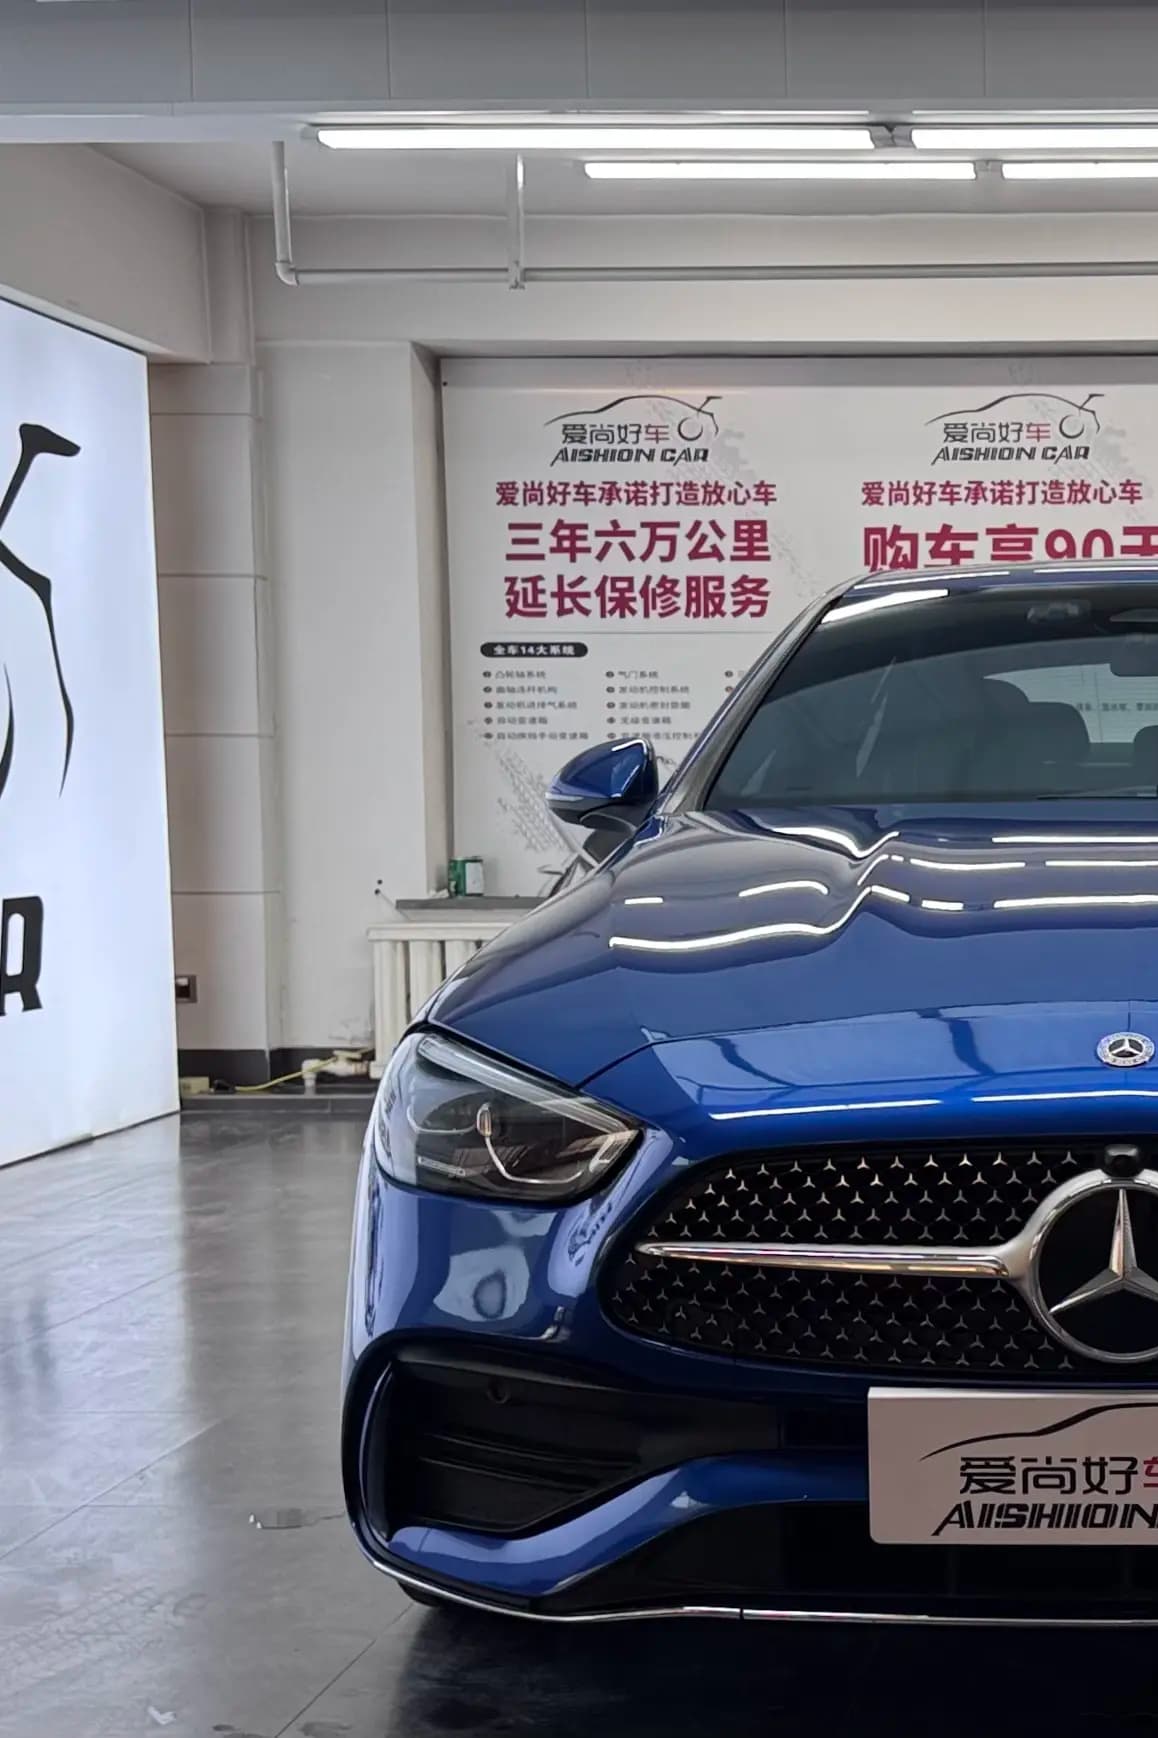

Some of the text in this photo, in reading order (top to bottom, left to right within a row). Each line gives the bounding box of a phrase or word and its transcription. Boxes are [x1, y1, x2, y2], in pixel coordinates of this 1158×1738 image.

[562, 424, 669, 444] 爱尚好车
[944, 422, 1050, 443] 爱尚好车
[550, 447, 708, 466] AISHION CAR
[931, 445, 1090, 465] AISHION CAR
[496, 480, 776, 506] 爱尚好车承诺打造放心车
[862, 479, 1142, 506] 爱尚好车承诺打造放心车
[506, 519, 771, 563] 三年六万公里
[504, 574, 770, 618] 延长保修服务
